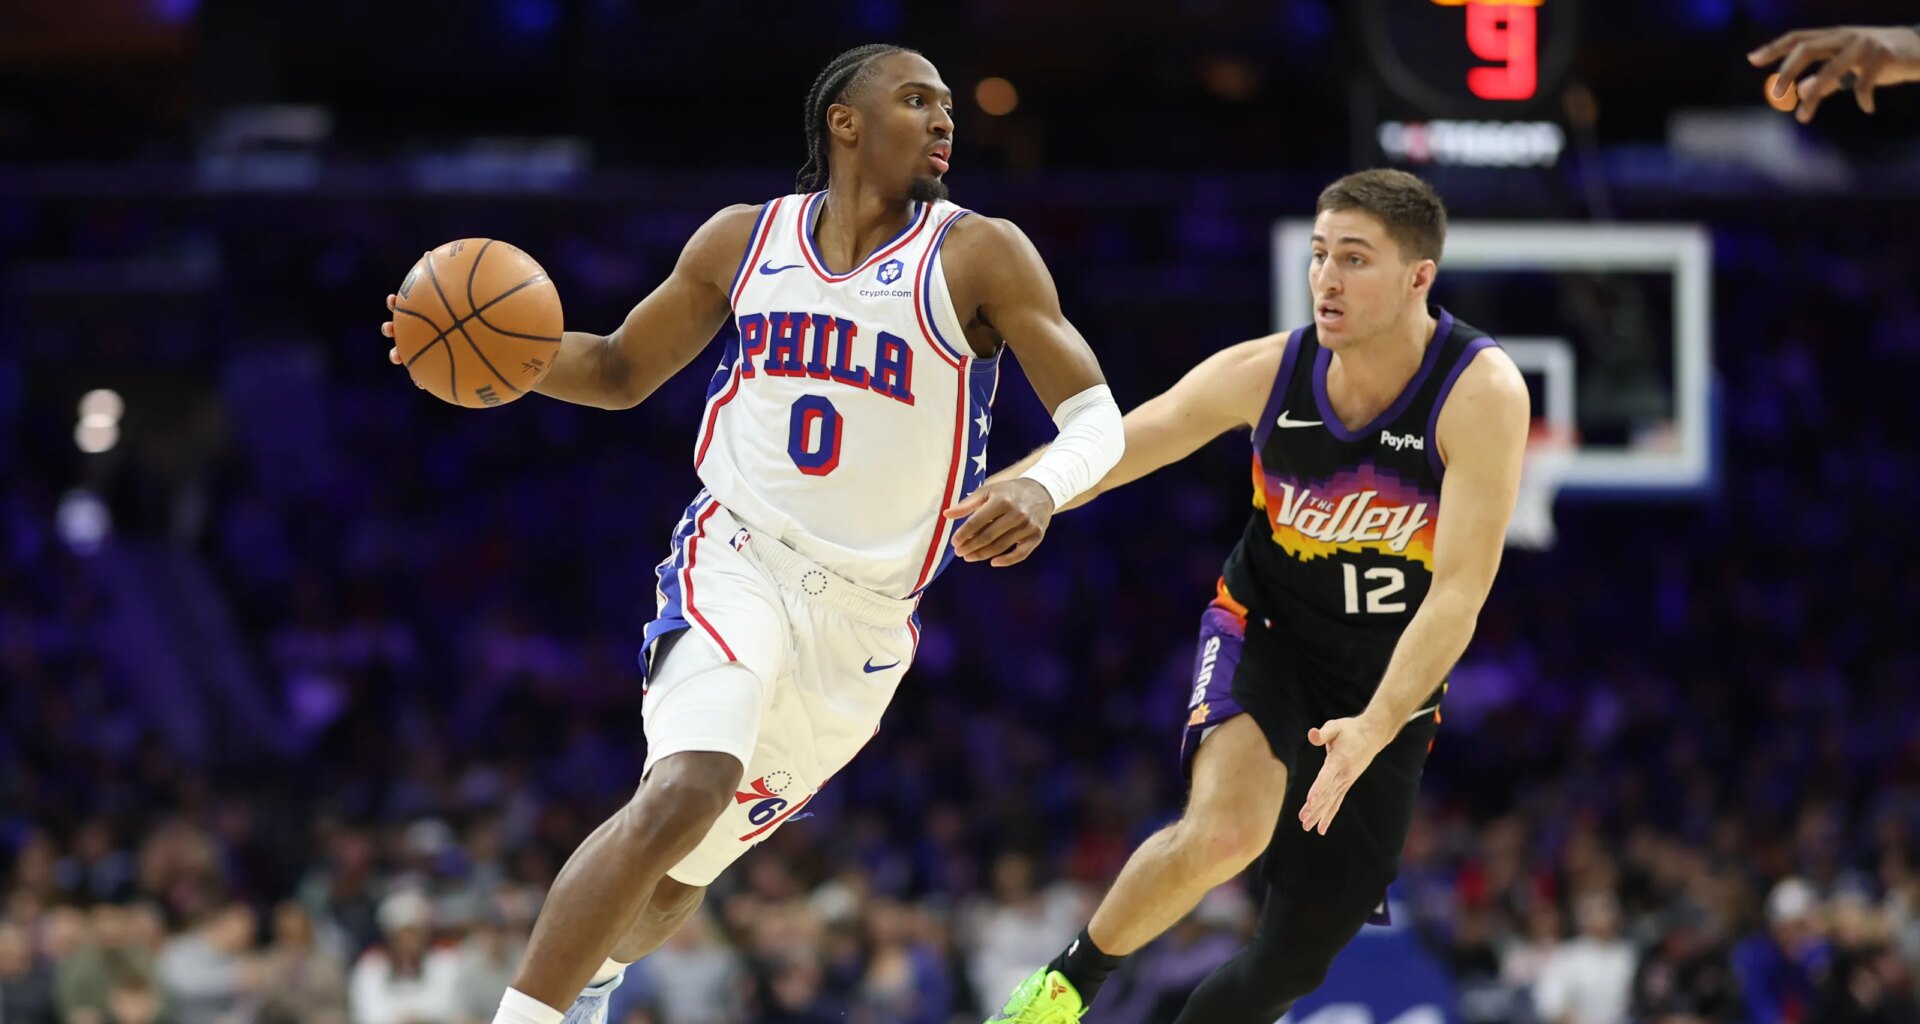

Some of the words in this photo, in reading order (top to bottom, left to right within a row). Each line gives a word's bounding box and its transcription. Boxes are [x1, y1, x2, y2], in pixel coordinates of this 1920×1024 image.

[1466, 1, 1538, 100] 9
[859, 289, 912, 298] crypto.com
[739, 312, 915, 406] PHILA
[787, 394, 843, 476] 0
[1381, 430, 1424, 451] PayPal
[1277, 482, 1429, 551] Valley
[1310, 497, 1334, 512] THE
[1342, 563, 1406, 614] 12
